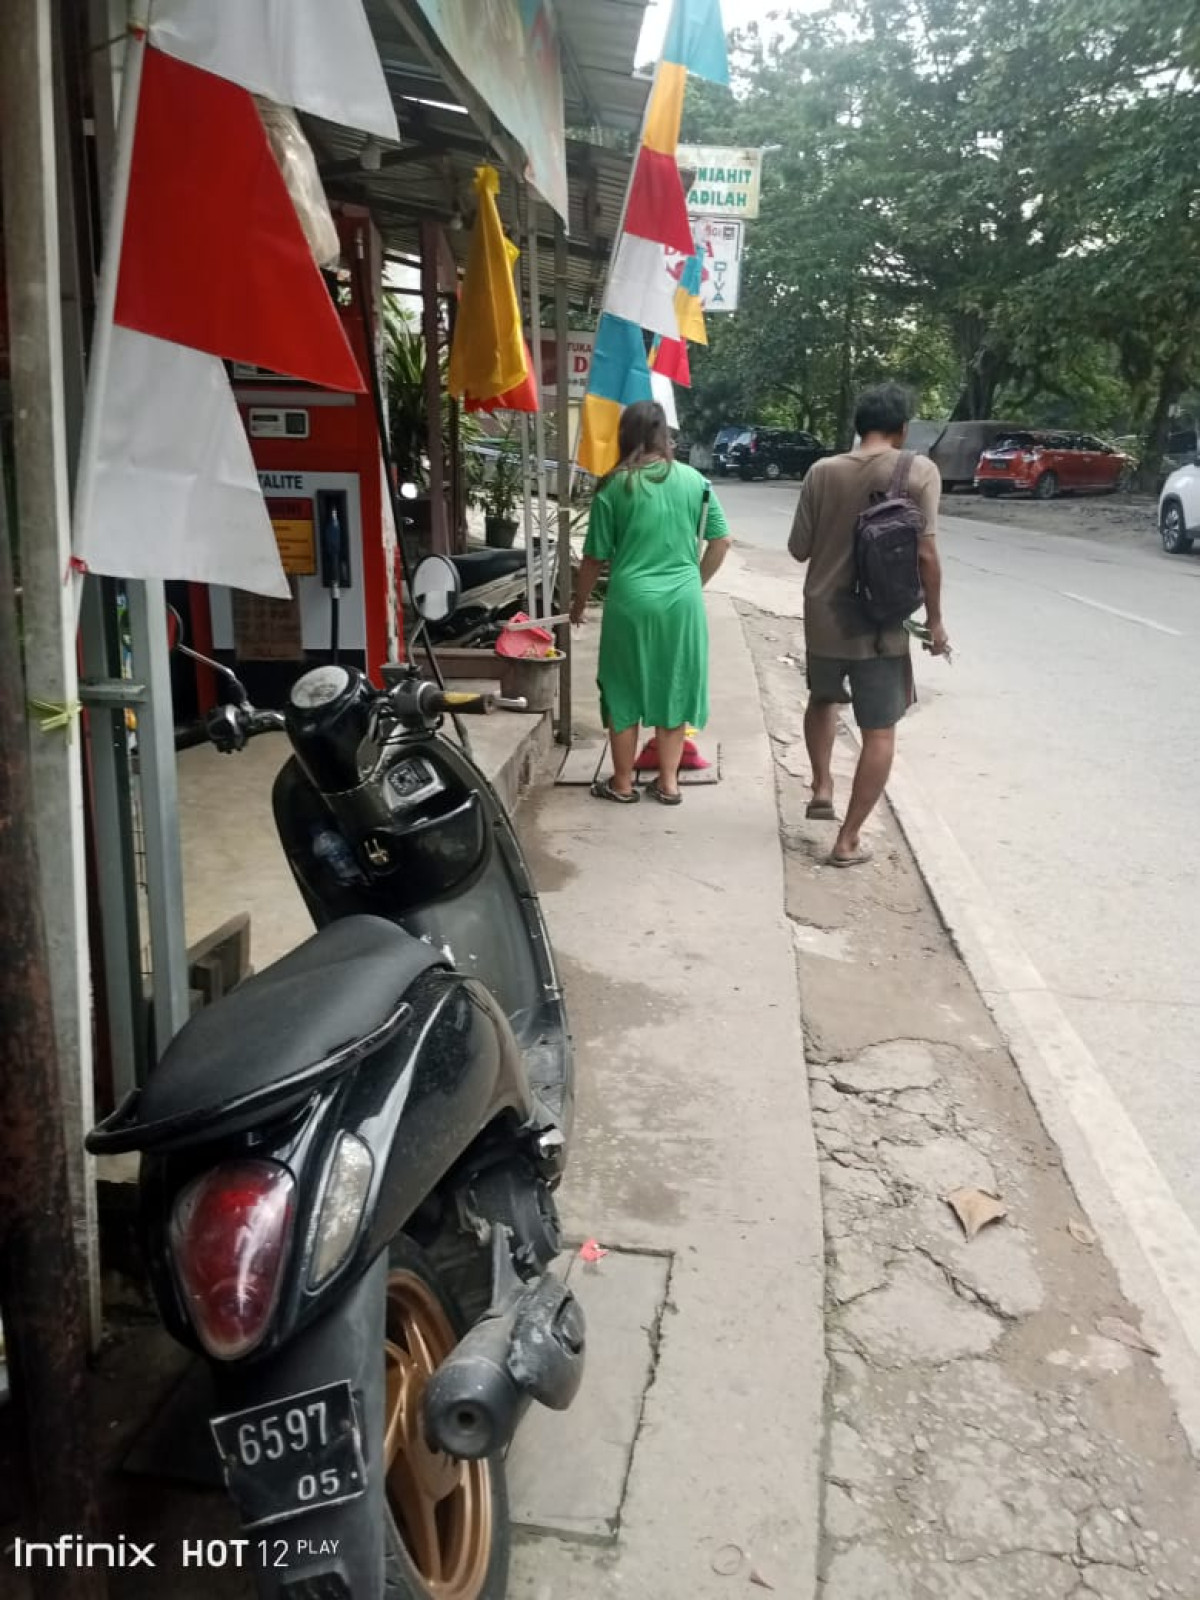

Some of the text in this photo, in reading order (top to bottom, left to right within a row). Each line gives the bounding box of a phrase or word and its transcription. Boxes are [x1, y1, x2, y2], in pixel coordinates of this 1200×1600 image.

[688, 189, 747, 208] ADILAH
[237, 1401, 328, 1466] 6597
[297, 1468, 341, 1501] 05
